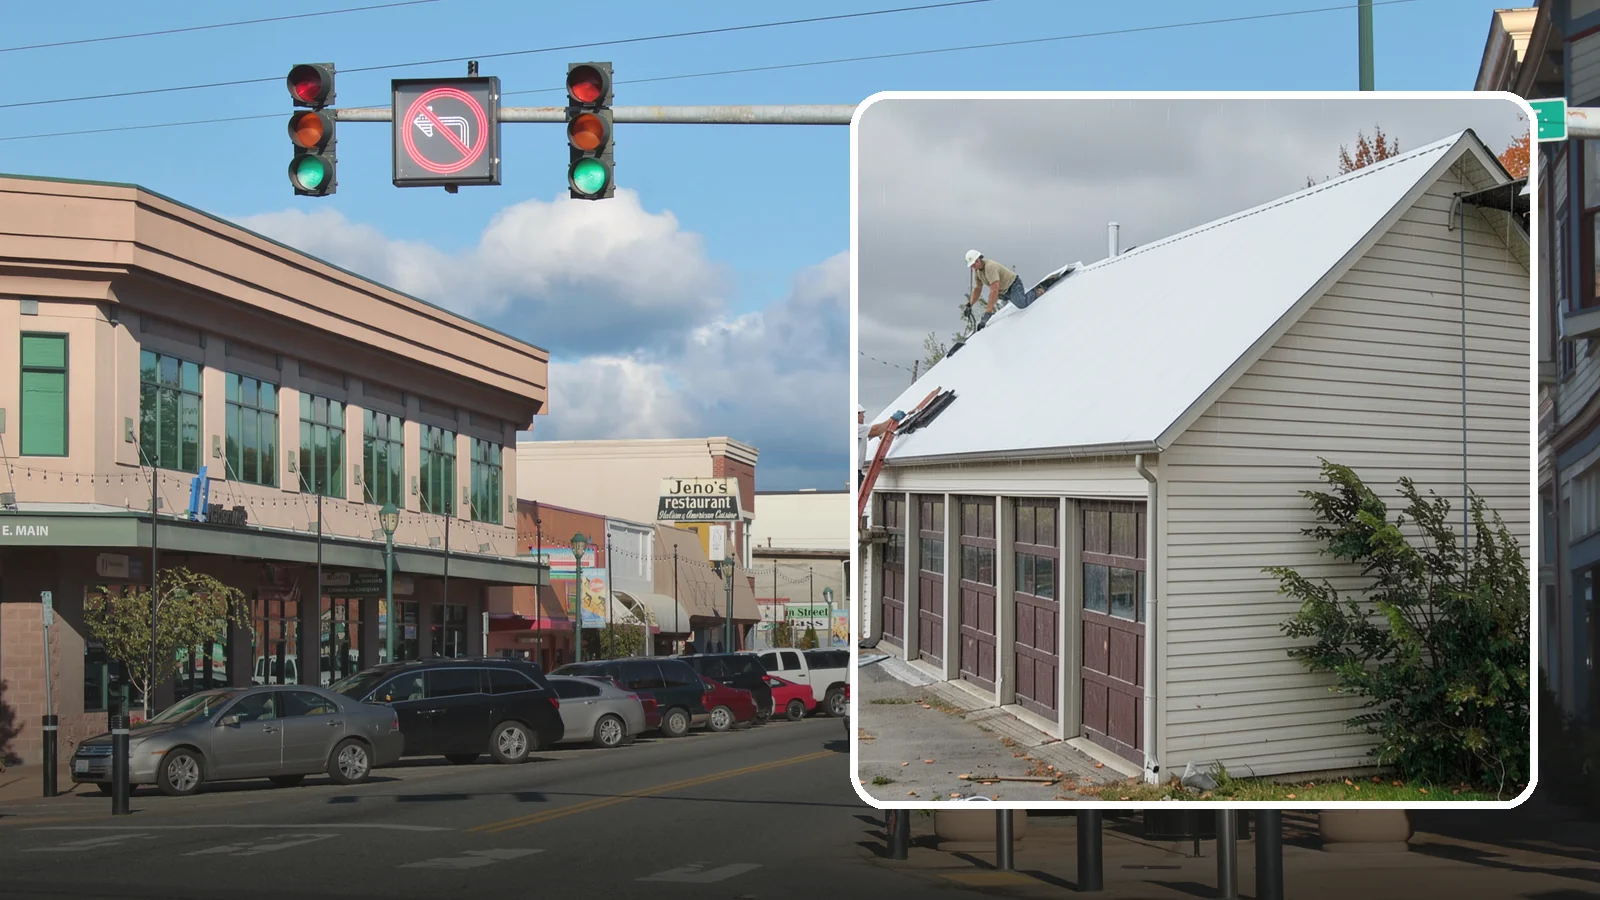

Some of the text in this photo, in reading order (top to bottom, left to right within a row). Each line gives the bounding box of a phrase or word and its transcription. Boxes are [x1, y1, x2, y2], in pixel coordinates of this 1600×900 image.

[669, 480, 728, 494] Jeno's
[665, 496, 731, 509] restaurant
[659, 510, 682, 520] Italian
[686, 510, 715, 519] American
[715, 510, 737, 519] Cuisine
[2, 525, 49, 536] E. MAIN
[797, 607, 828, 617] Street
[791, 619, 823, 627] lass
